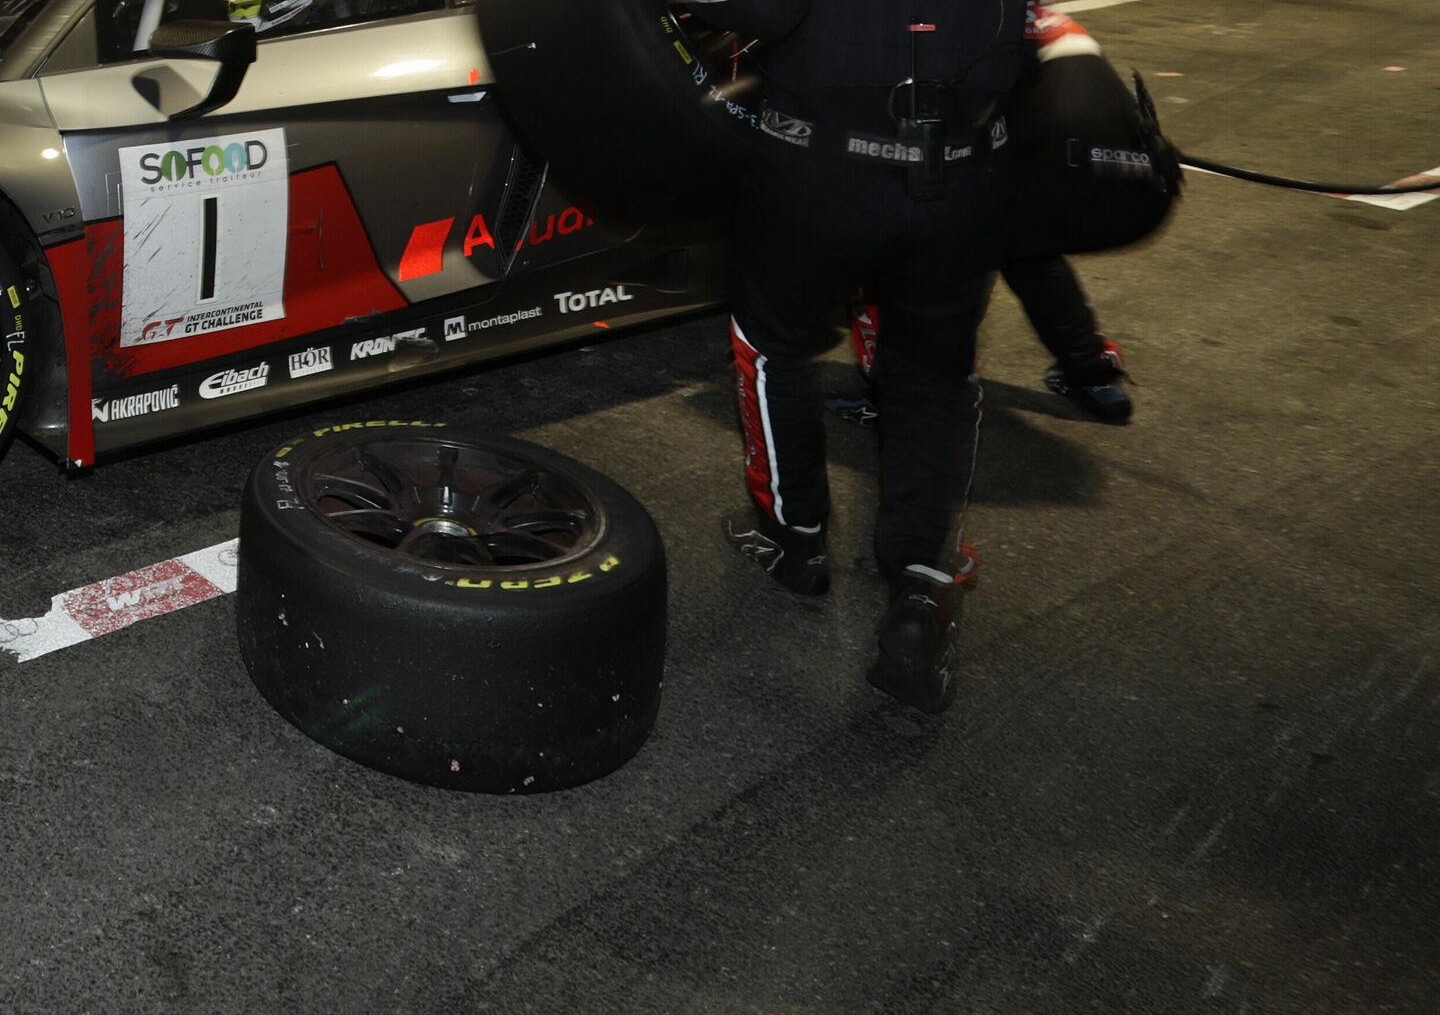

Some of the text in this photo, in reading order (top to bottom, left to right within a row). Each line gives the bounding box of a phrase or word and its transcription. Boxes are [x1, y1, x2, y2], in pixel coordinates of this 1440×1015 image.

[139, 140, 268, 185] SOFOOD
[1091, 146, 1151, 166] sparco
[150, 171, 263, 193] service traiteur
[200, 197, 218, 301] 1
[186, 300, 264, 323] INTERCONTINENTAL
[554, 285, 634, 314] TOTAL
[185, 309, 264, 334] GT CHALLENGE
[468, 306, 544, 332] montaplast
[199, 361, 270, 399] Eibach
[314, 419, 447, 438] PIRELLI
[456, 571, 592, 589] ZERO
